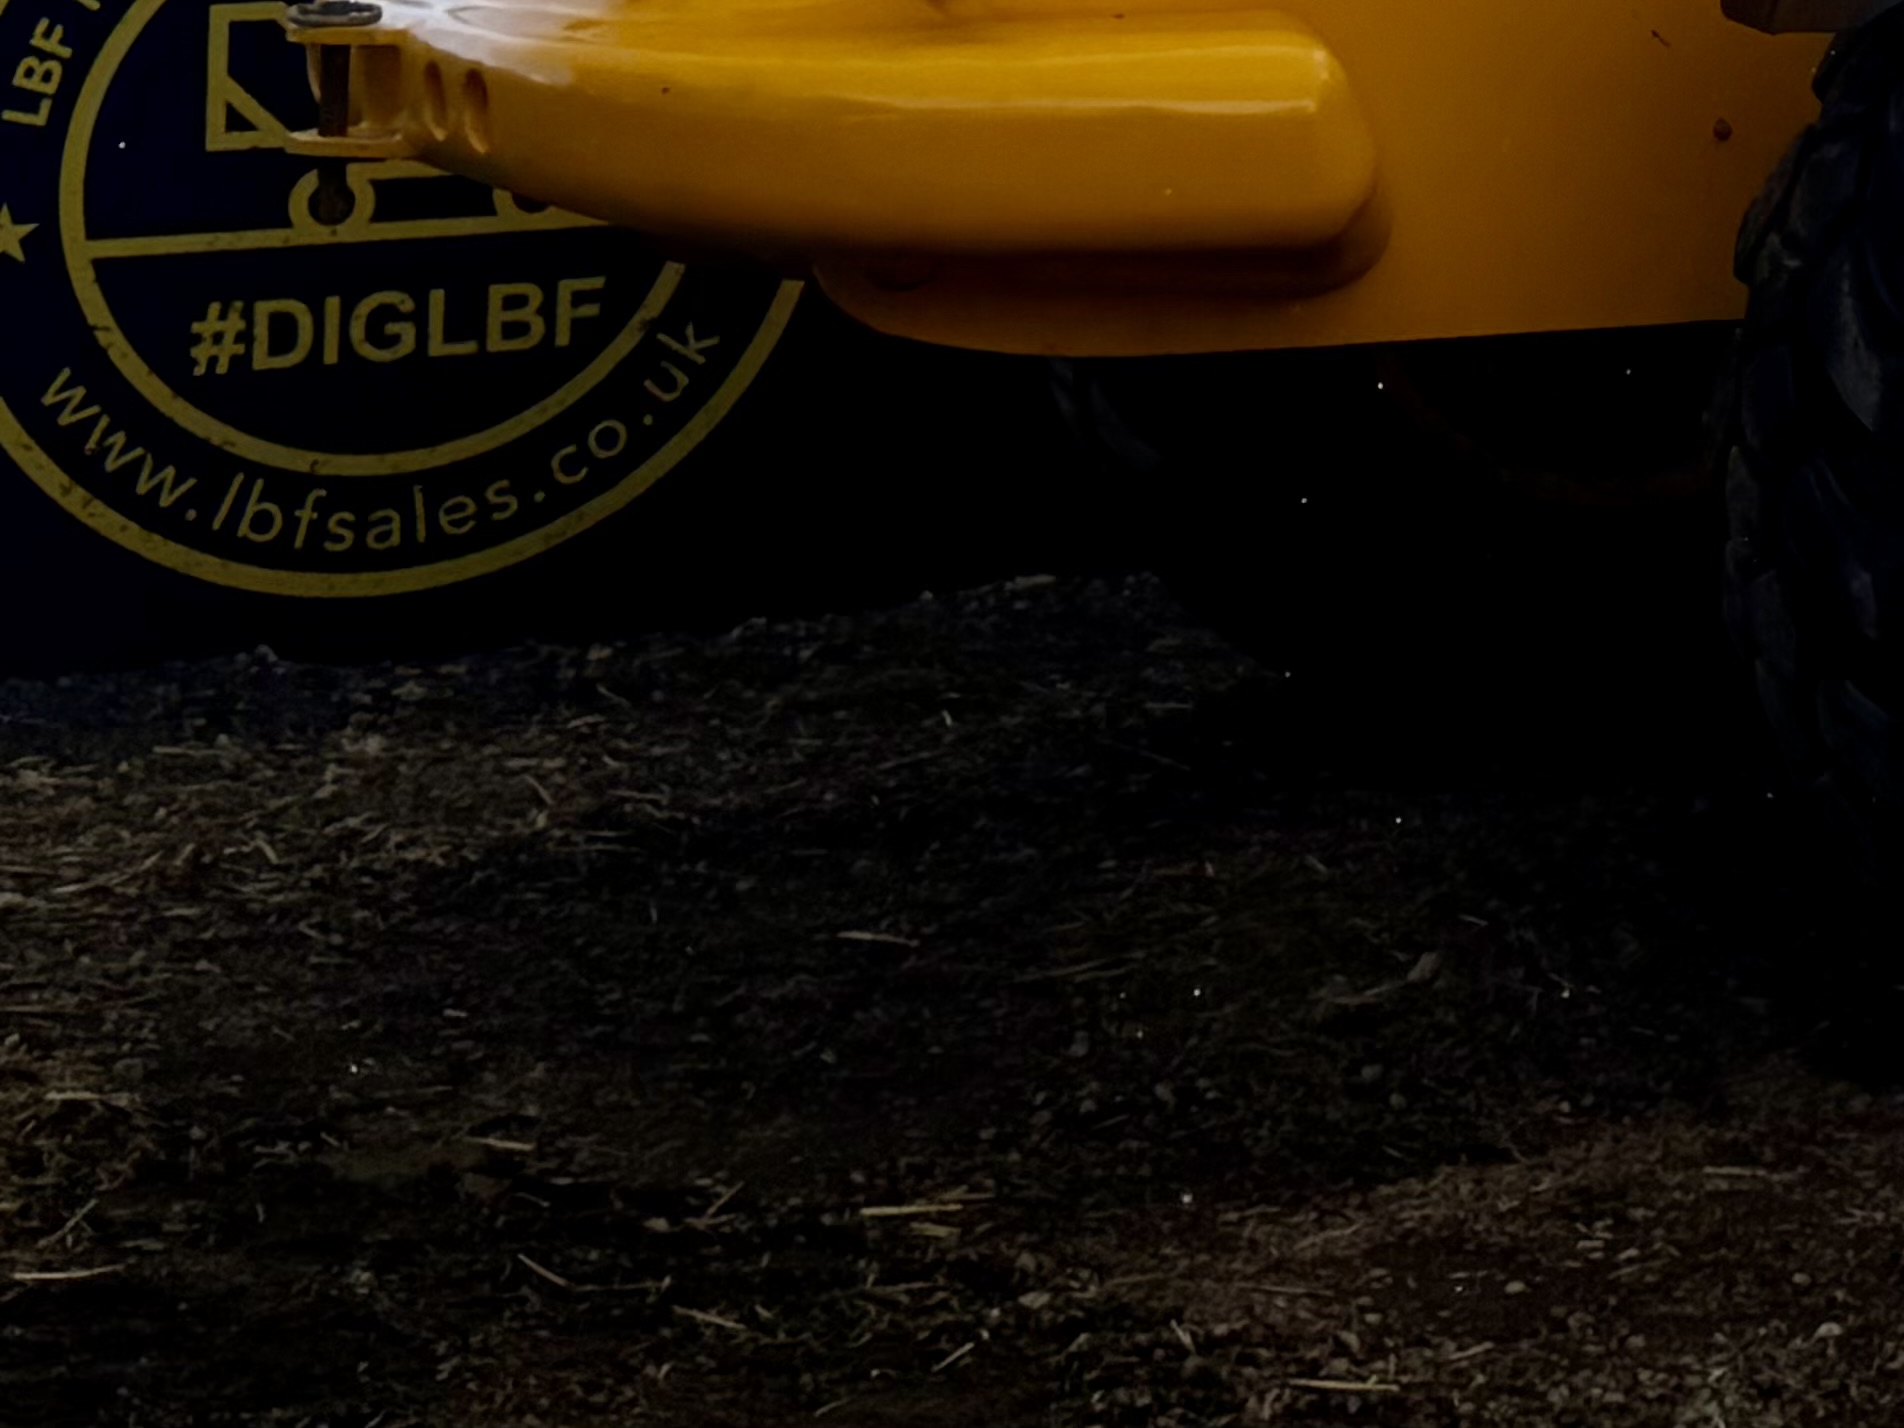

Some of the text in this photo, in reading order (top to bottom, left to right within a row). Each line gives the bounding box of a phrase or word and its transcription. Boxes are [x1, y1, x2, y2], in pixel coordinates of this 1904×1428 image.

[2, 17, 73, 127] LBF
[190, 276, 606, 377] #DIGLBF
[40, 322, 721, 553] www.lbfsales.co.uk
